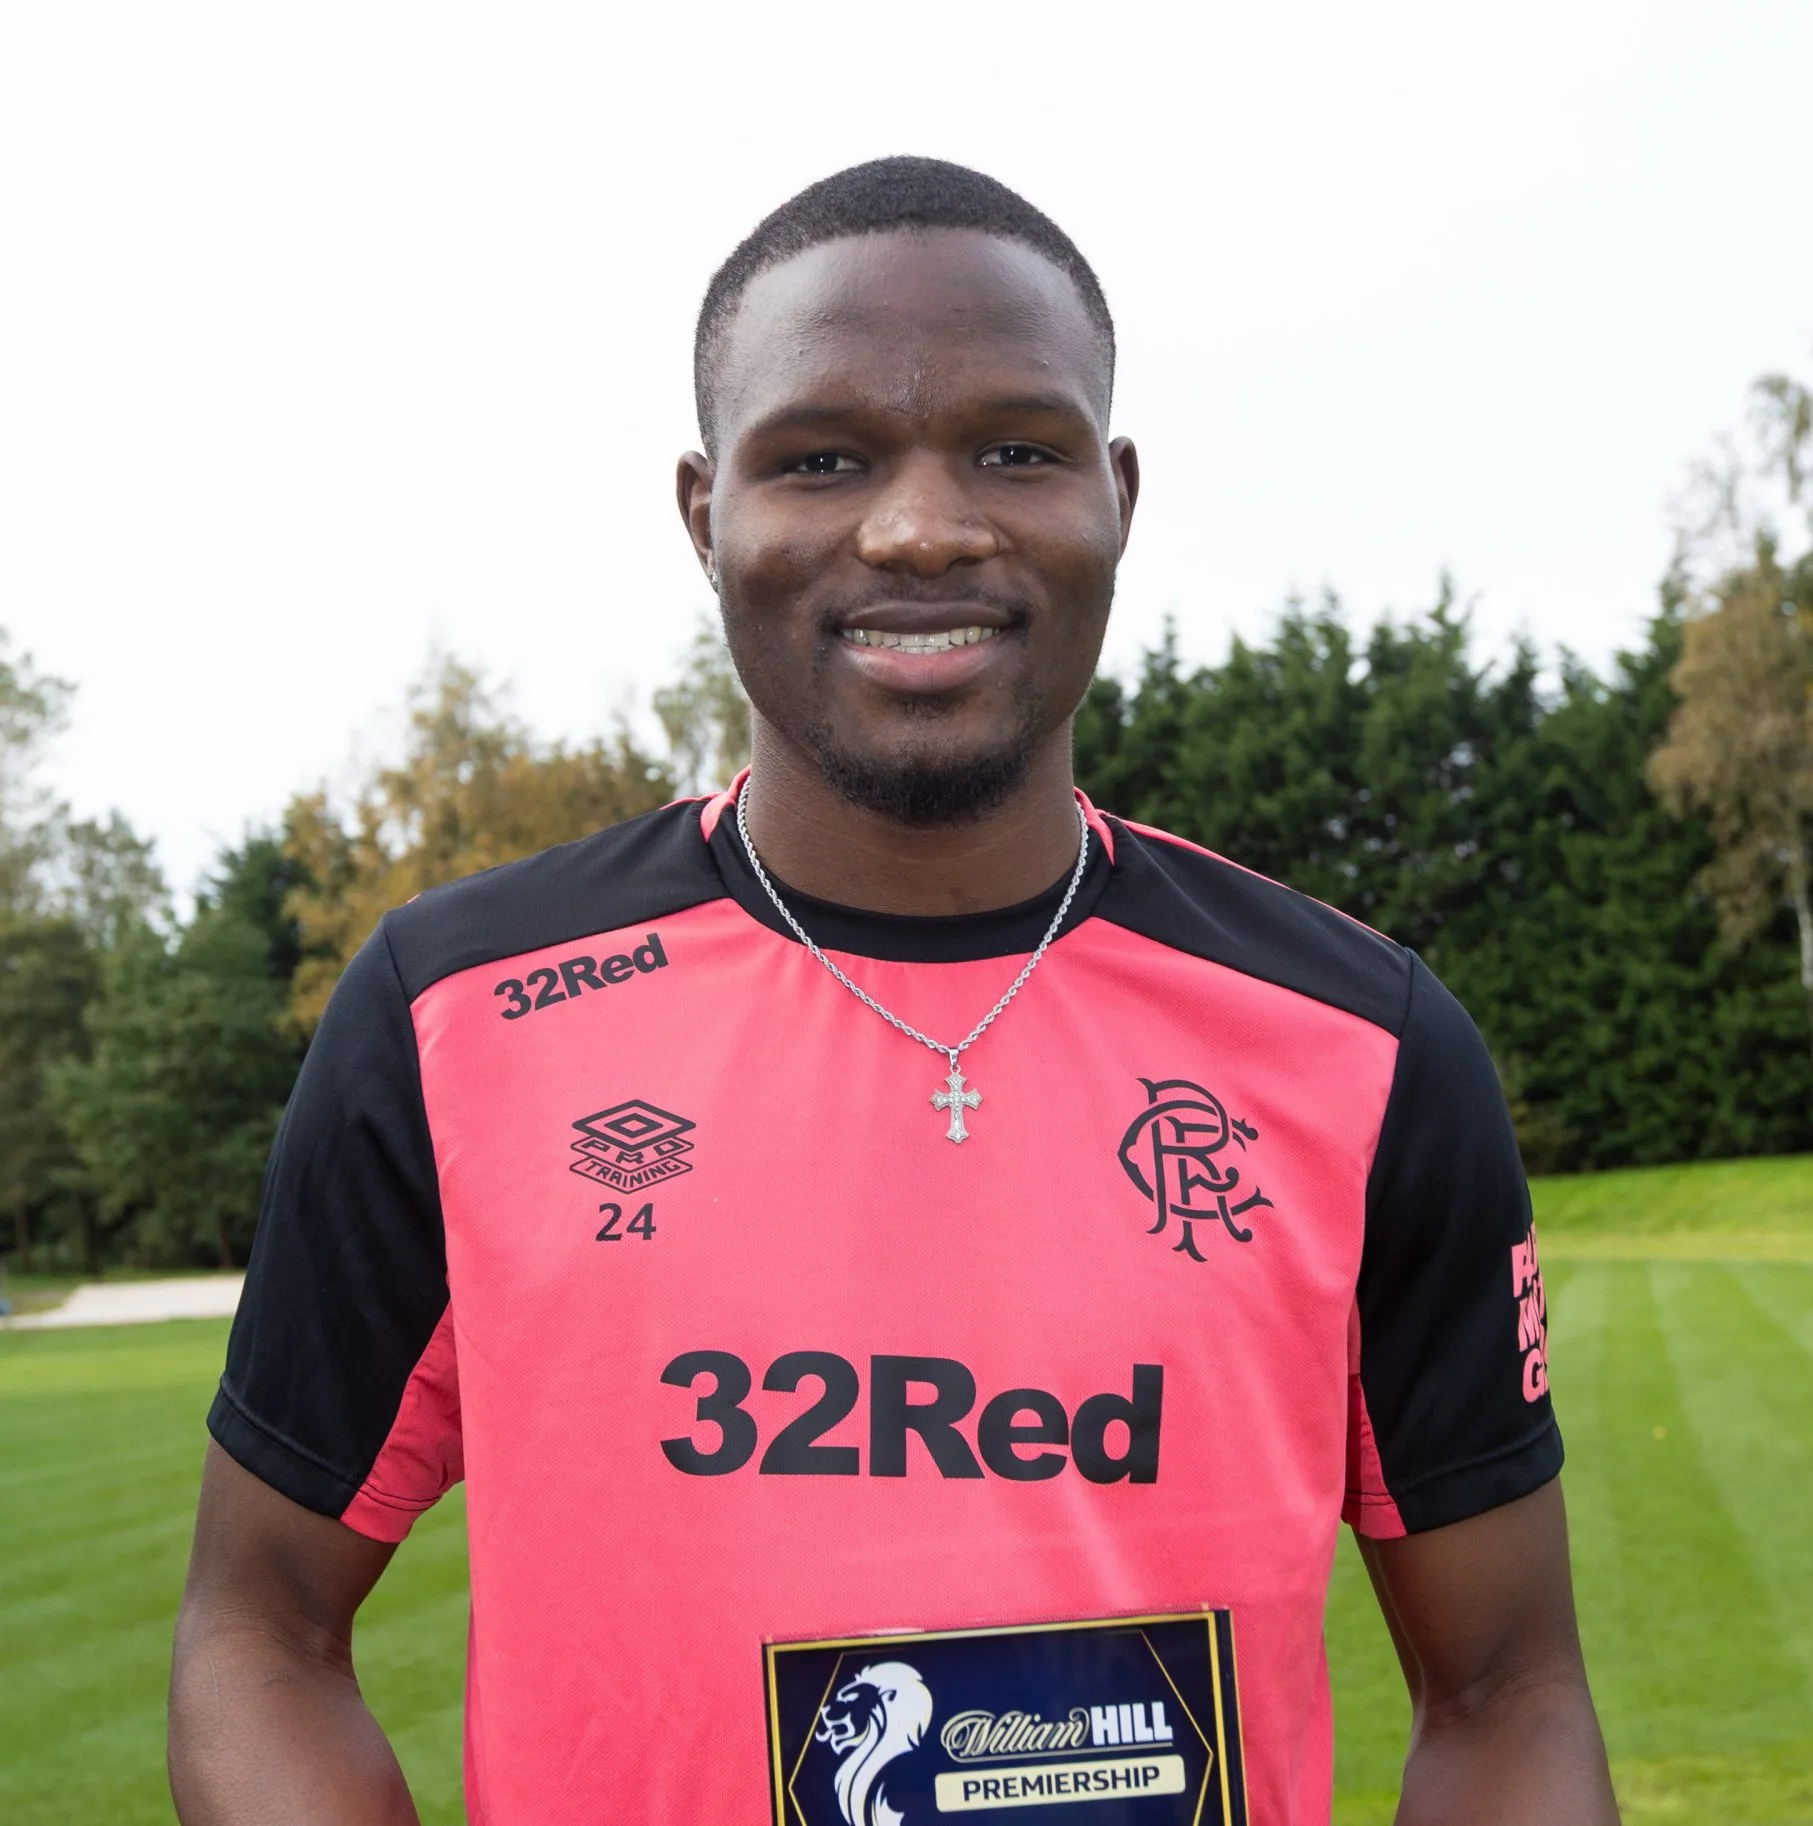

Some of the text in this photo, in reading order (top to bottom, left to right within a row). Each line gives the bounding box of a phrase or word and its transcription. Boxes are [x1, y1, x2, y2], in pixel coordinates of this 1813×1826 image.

[493, 932, 669, 1020] 32Red
[581, 1139, 684, 1165] PRO
[585, 1160, 682, 1188] TRAINING
[595, 1203, 657, 1241] 24
[659, 1350, 1164, 1485] 32Red
[940, 1701, 1174, 1759] William HILL
[962, 1765, 1160, 1802] PREMIERSHIP
